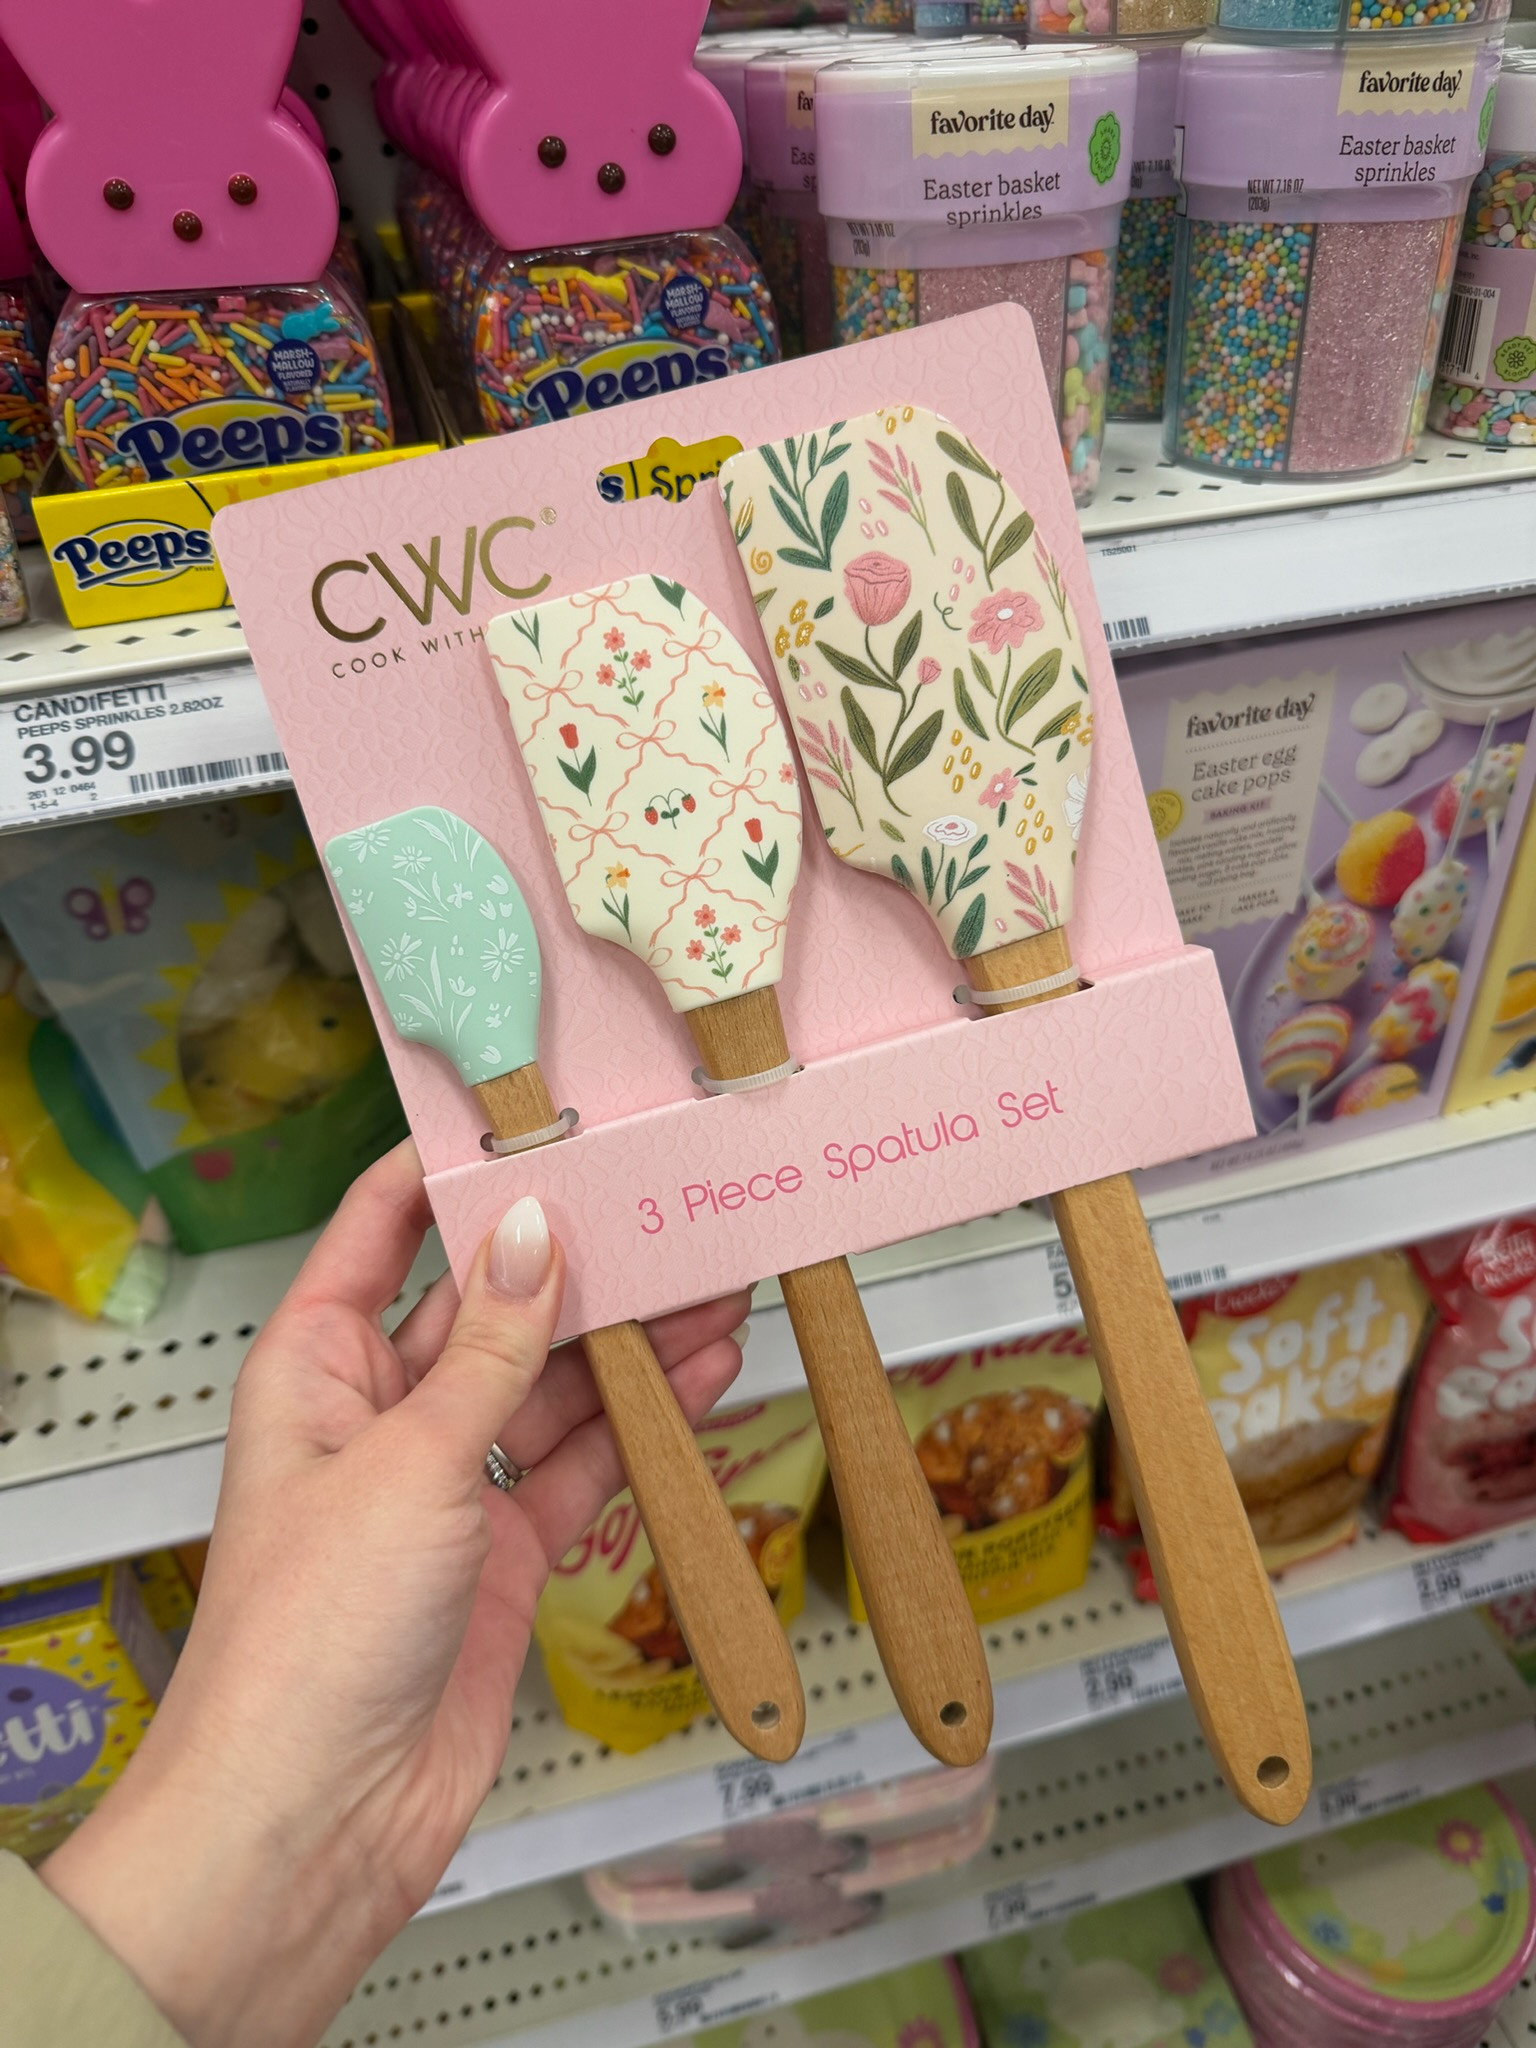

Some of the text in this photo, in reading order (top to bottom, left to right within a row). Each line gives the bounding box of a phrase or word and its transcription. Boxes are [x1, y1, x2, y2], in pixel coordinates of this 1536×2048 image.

[1359, 69, 1462, 98] favorite day
[931, 102, 1055, 135] favorite day
[1339, 133, 1456, 156] Easter basket
[923, 170, 1060, 201] Easter basket
[1248, 180, 1262, 194] NET
[1262, 180, 1275, 194] WT
[1276, 179, 1292, 194] 7.16
[1355, 161, 1436, 187] sprinkles
[946, 201, 1042, 229] sprinkles
[272, 358, 315, 372] MALLOW
[273, 348, 314, 361] MARSH-
[116, 413, 344, 483] Peeps
[54, 529, 214, 580] Peeps
[312, 516, 552, 643] CWC
[332, 626, 485, 679] COOK WITH
[14, 683, 168, 724] CANDIFETTI
[18, 696, 225, 739] PEEPS SPRINKLES 2.82OZ
[1186, 692, 1316, 738] favorite day
[23, 730, 136, 784] 3.99
[1192, 744, 1298, 781] Easter egg
[28, 789, 47, 801] 261
[53, 786, 66, 797] 12
[1192, 769, 1292, 802] cake pops
[638, 1080, 1064, 1235] 3 Piece Spatula Set
[1219, 1276, 1385, 1394] Soft
